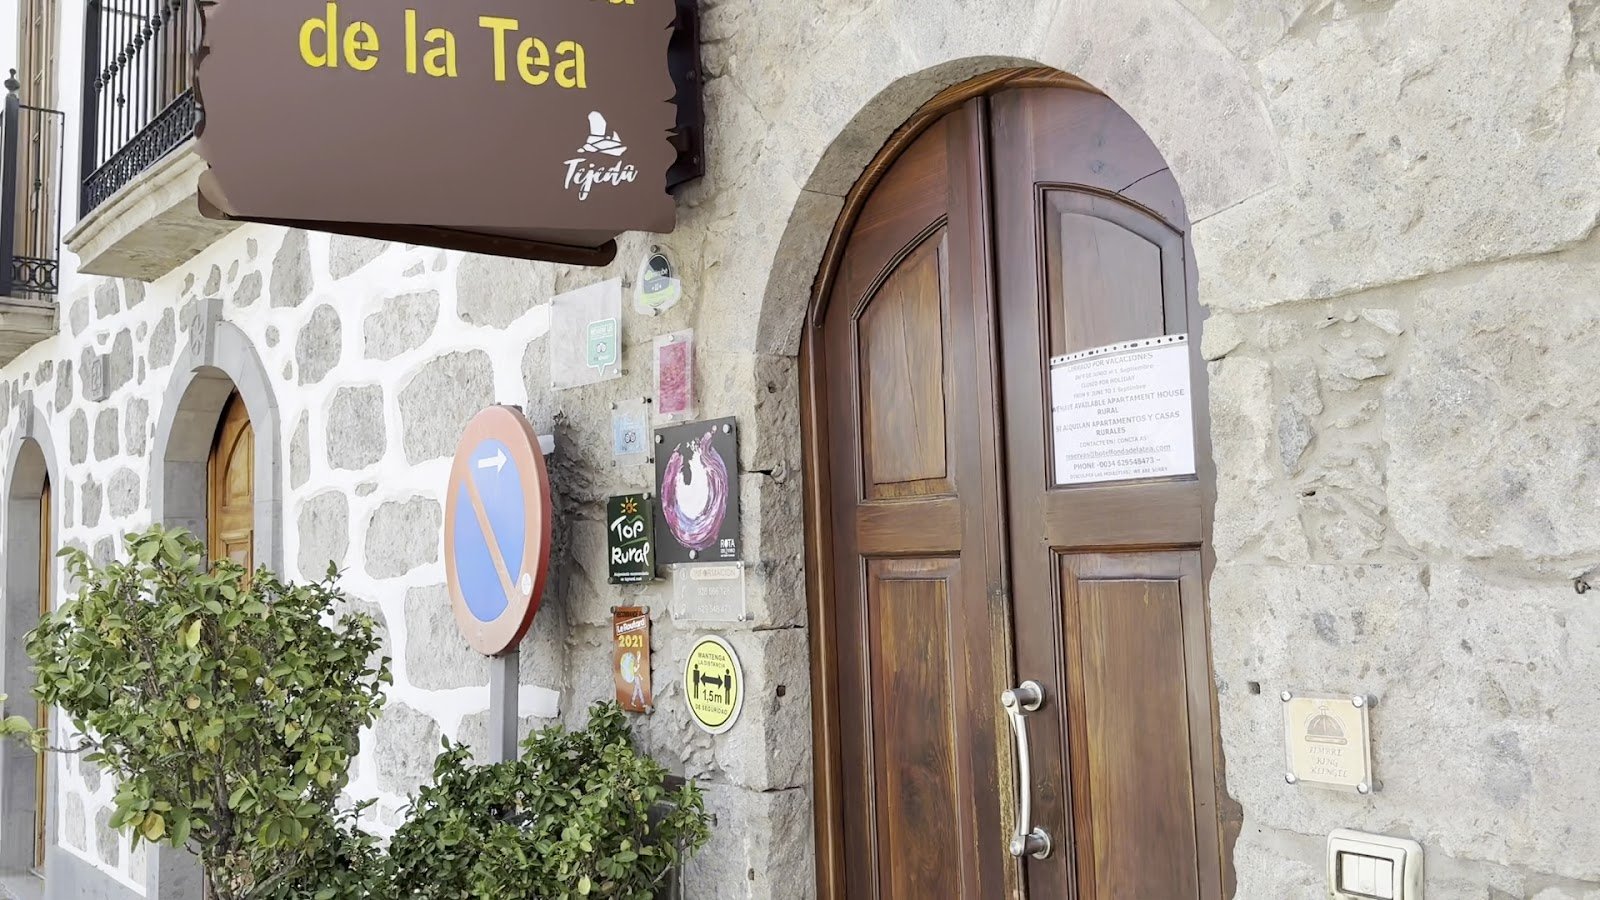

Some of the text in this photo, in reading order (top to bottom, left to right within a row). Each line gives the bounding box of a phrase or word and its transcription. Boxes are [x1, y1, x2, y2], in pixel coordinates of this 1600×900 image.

[299, 2, 588, 89] de la Tea
[563, 157, 639, 201] Tejeda
[1105, 352, 1153, 365] VACACIONES
[1110, 375, 1134, 383] HOLIDAY
[1074, 399, 1106, 409] AVAILABLE
[1107, 392, 1154, 405] APARTAMENT
[1157, 388, 1184, 398] HOUSE
[1097, 406, 1119, 415] RURAL
[1062, 422, 1090, 432] ALQUILAN
[1092, 415, 1145, 428] APARTAMENTOS
[1155, 411, 1180, 420] CASAS
[1096, 427, 1125, 436] RURALES
[611, 542, 650, 567] Rural
[618, 634, 643, 648] 2021
[697, 652, 726, 662] MANTENGA
[702, 705, 728, 716] SEGURIDAD
